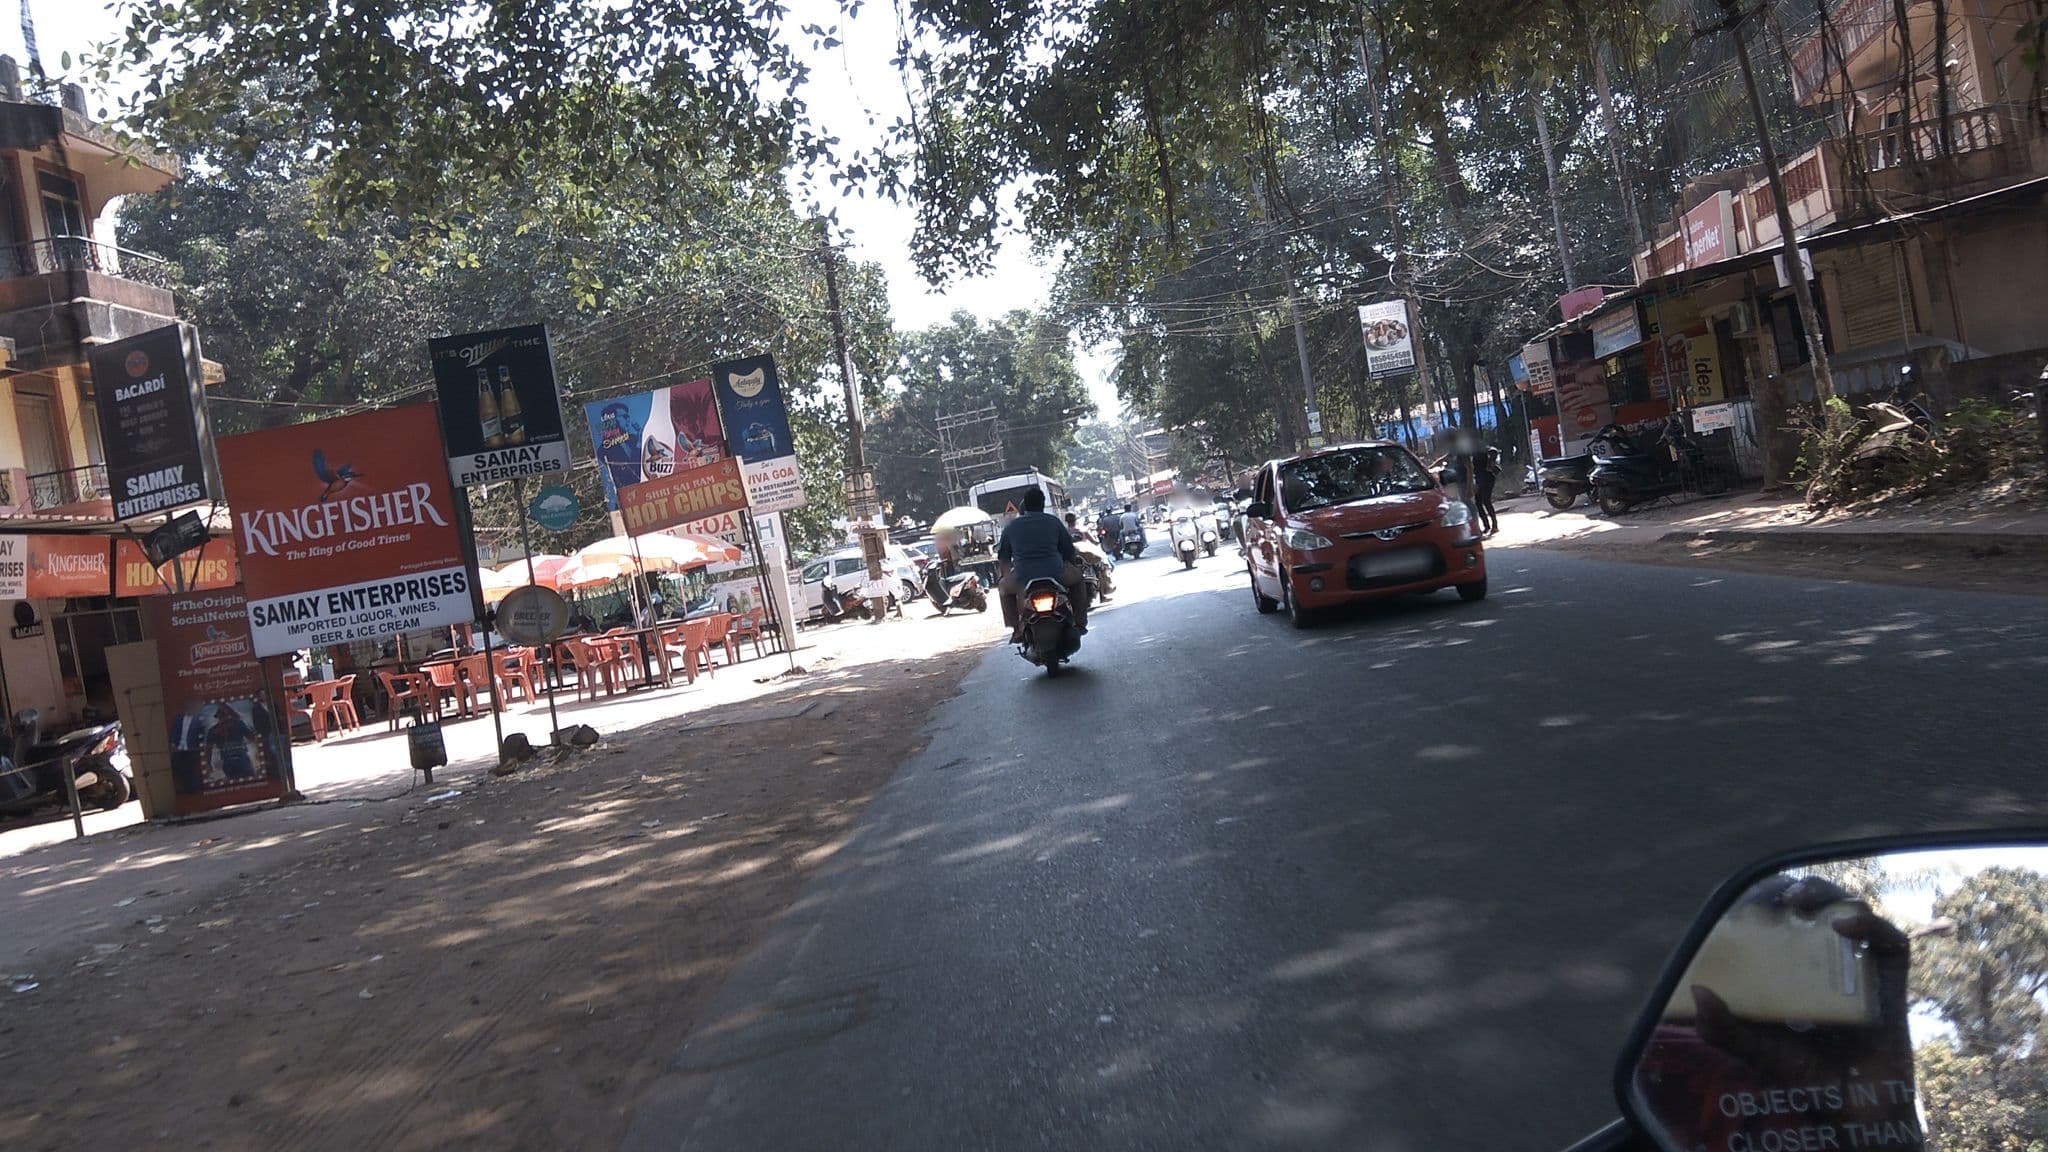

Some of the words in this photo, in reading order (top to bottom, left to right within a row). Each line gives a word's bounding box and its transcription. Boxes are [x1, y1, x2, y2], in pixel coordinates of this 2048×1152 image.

[512, 336, 541, 348] TIME
[474, 445, 542, 469] SAMAY
[126, 465, 184, 497] SAMAY
[461, 458, 561, 484] ENTERPRISES
[772, 467, 794, 480] GOA
[645, 488, 670, 501] SHRI
[673, 483, 690, 495] SAI
[693, 475, 715, 489] RAM
[764, 479, 797, 491] RESTAURANT
[117, 482, 200, 518] ENTERPRISES
[625, 500, 668, 529] HOT
[674, 479, 743, 514] CHIPS
[240, 482, 448, 556] KINGFISHER
[686, 514, 737, 535] GOA
[286, 549, 306, 561] The
[309, 546, 333, 560] King
[335, 542, 346, 554] of
[348, 538, 376, 551] Good
[377, 532, 411, 545] Times
[48, 552, 107, 576] KINGFISHER
[126, 562, 165, 587] HOT
[172, 559, 228, 585] HIPS
[172, 595, 247, 611] #TheOrigin
[252, 596, 321, 628] SAMAY
[326, 571, 467, 615] ENTERPRISES
[172, 610, 249, 626] SocialNetwo
[287, 616, 347, 636] IMPORTED
[350, 608, 397, 627] LIQUOR,
[400, 600, 440, 617] WINES,
[513, 612, 550, 621] BREEER
[312, 632, 343, 645] BEER
[346, 629, 354, 639] &
[357, 625, 375, 638] ICE
[378, 617, 420, 635] CREAM
[194, 641, 246, 658] KINGFISHER
[1719, 1086, 1842, 1118] OBJECTS
[1850, 1082, 1878, 1107] IN
[1728, 1126, 1838, 1152] CLOSER
[1843, 1120, 1920, 1150] THAN
